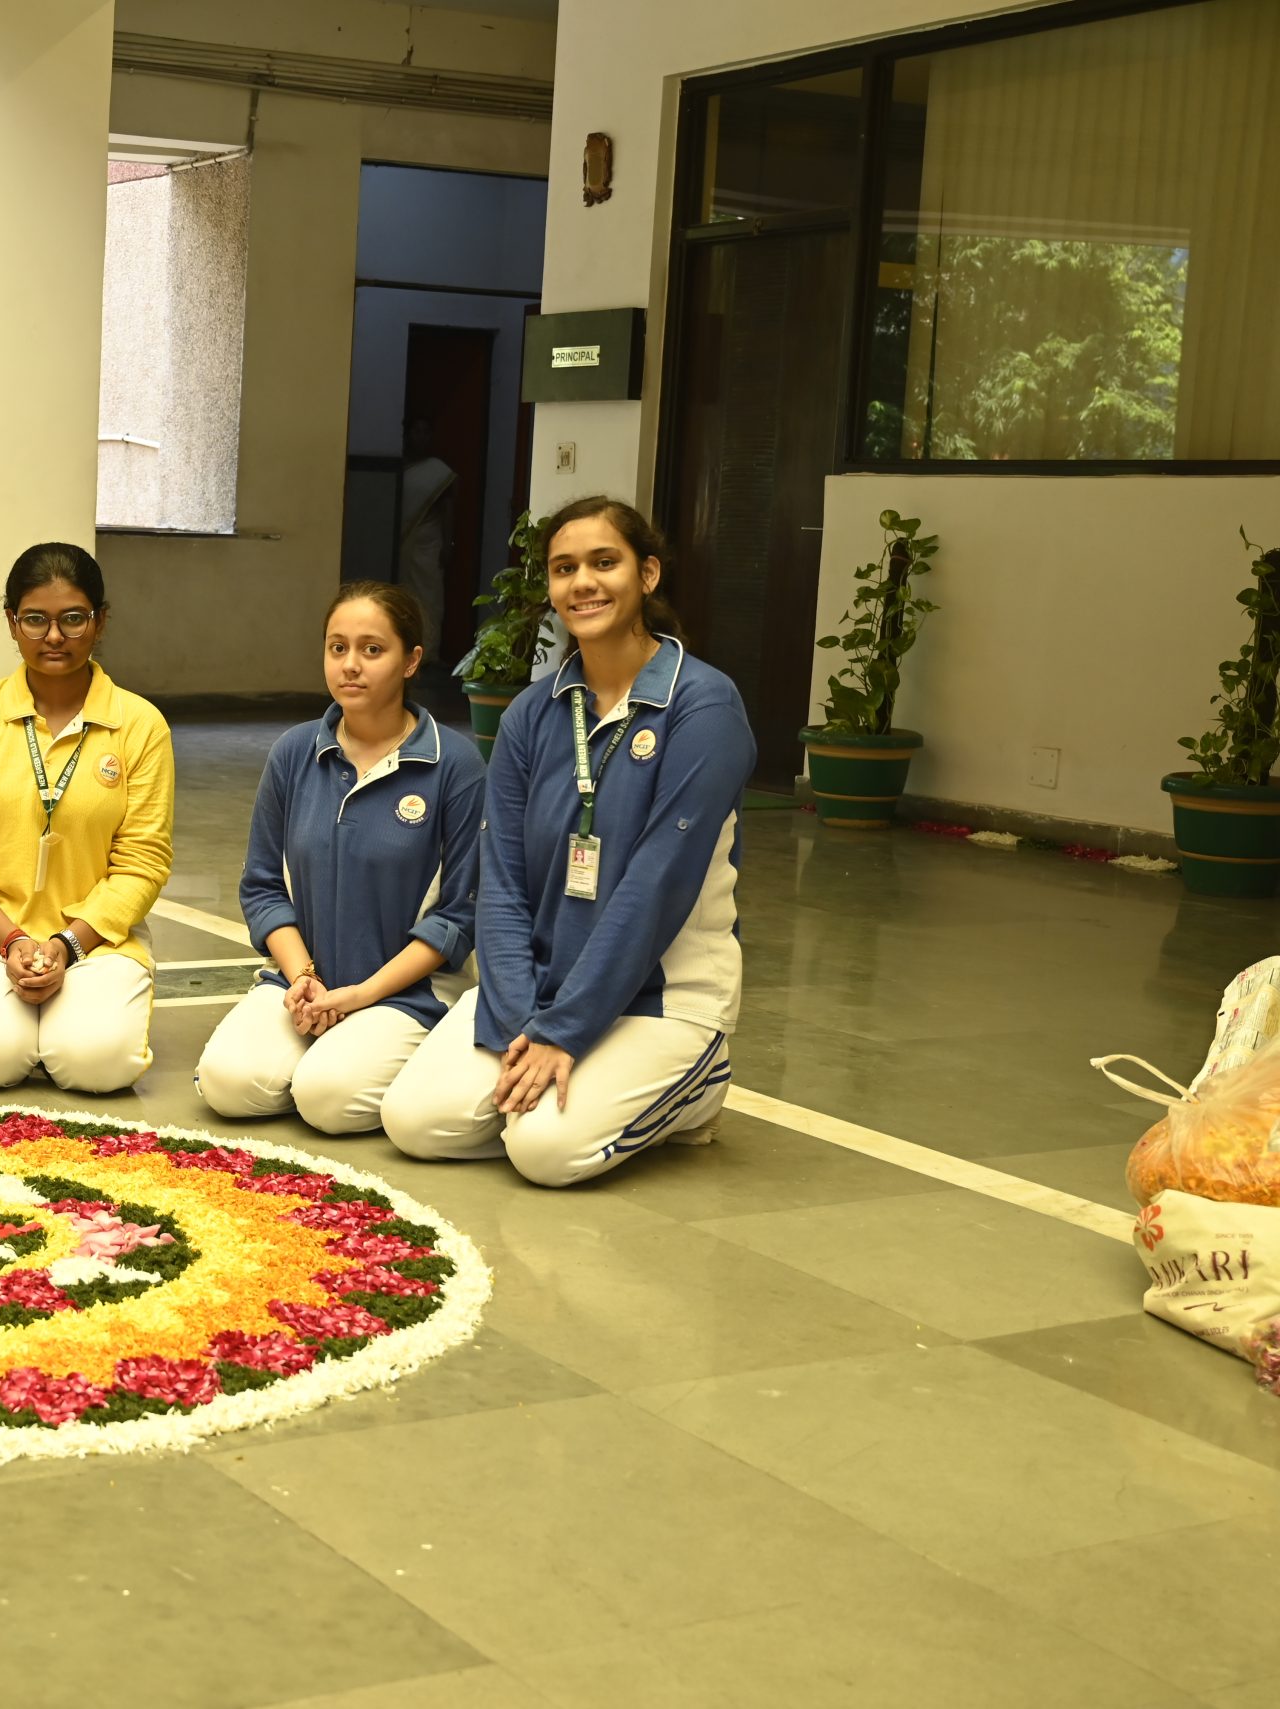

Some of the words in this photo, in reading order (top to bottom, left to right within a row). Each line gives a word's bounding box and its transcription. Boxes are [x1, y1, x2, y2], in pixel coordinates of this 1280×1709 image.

[555, 351, 596, 362] PRINCIPAL
[576, 729, 585, 744] FIELD
[612, 728, 624, 745] FIELD
[30, 743, 38, 757] FIELD
[578, 745, 587, 764] GREEN
[34, 757, 43, 774] GREEN
[58, 775, 68, 787] NEW
[65, 760, 76, 776] GREEN
[580, 765, 588, 777] NEW
